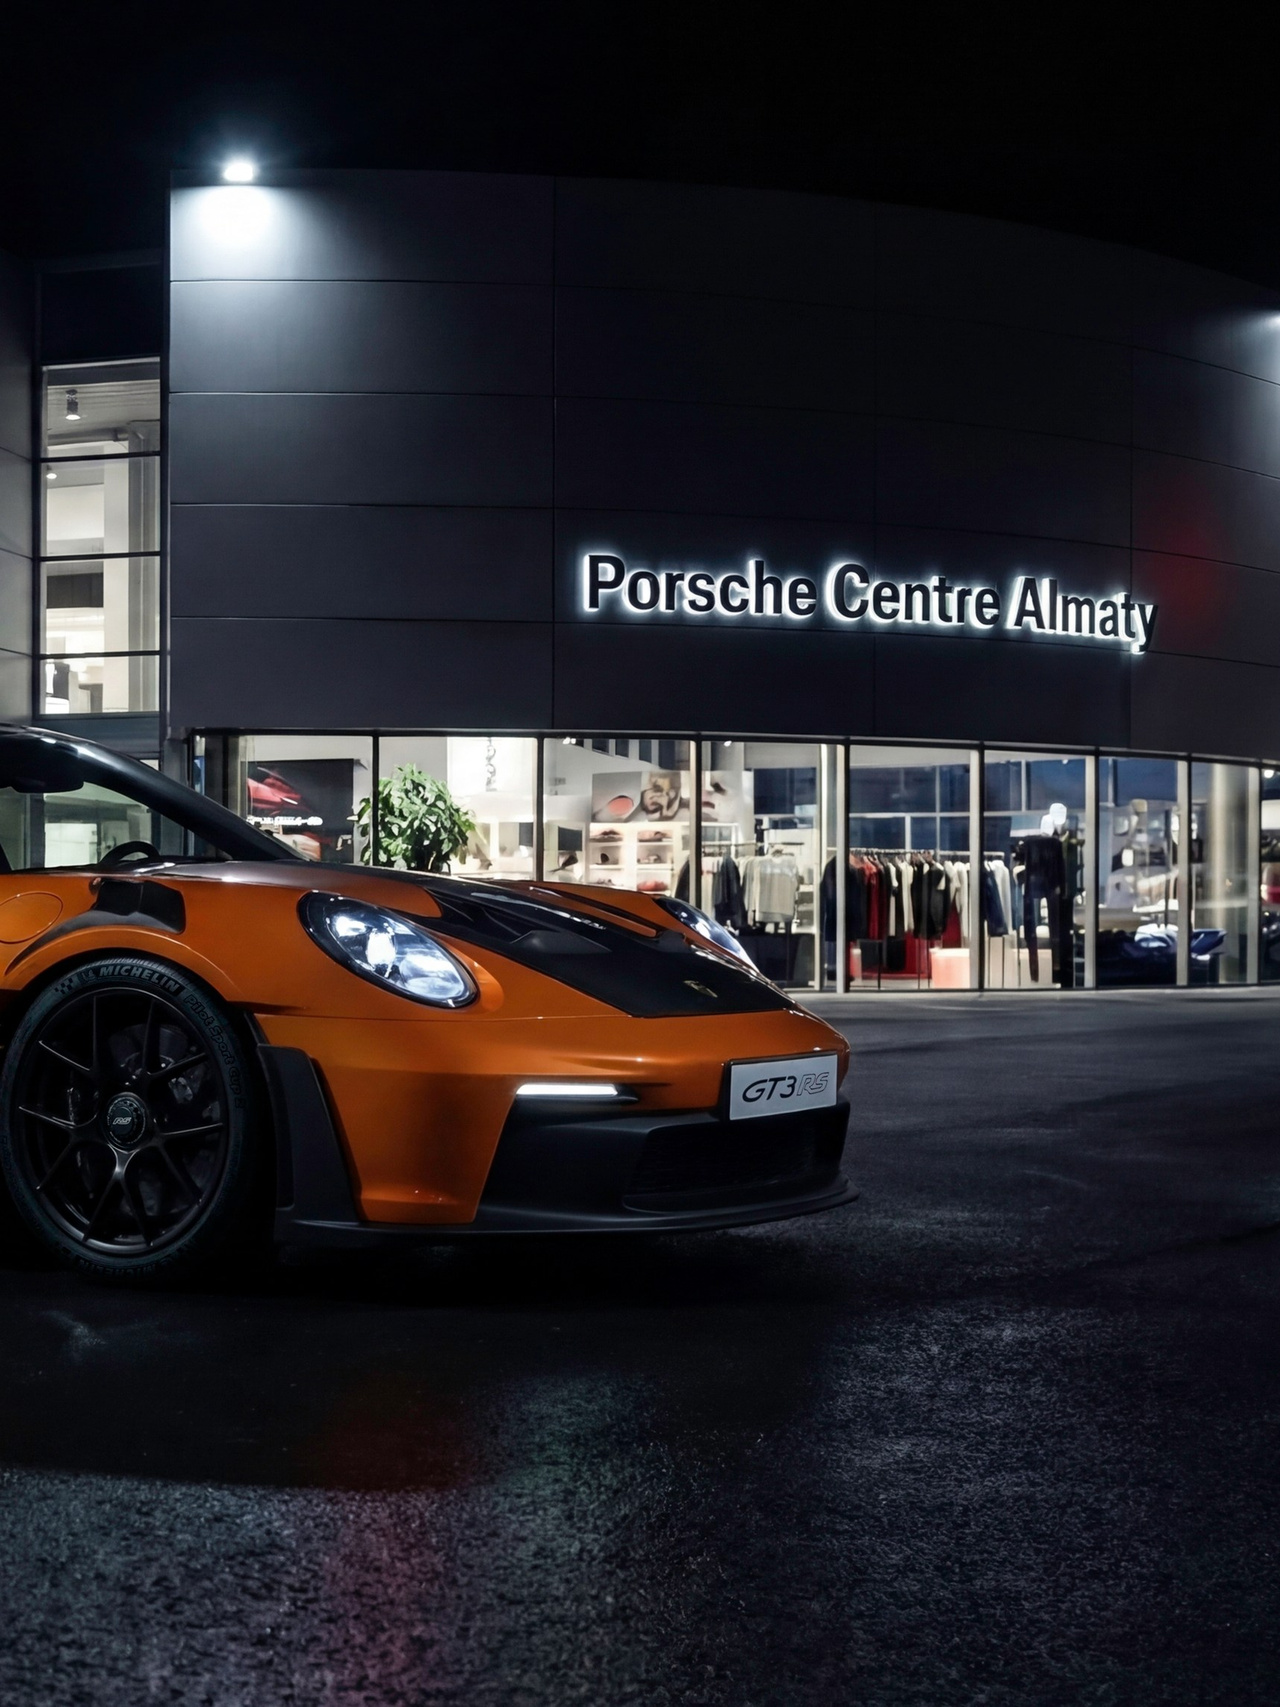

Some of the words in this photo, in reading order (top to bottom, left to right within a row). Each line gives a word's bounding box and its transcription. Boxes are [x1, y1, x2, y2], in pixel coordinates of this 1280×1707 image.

[584, 553, 817, 617] Porsche
[830, 562, 1001, 627] Centre
[1008, 576, 1158, 655] Almaty
[99, 965, 181, 992] MICHELIN
[184, 994, 215, 1027] Pilot
[210, 1024, 234, 1066] Sport
[228, 1066, 242, 1095] Cup
